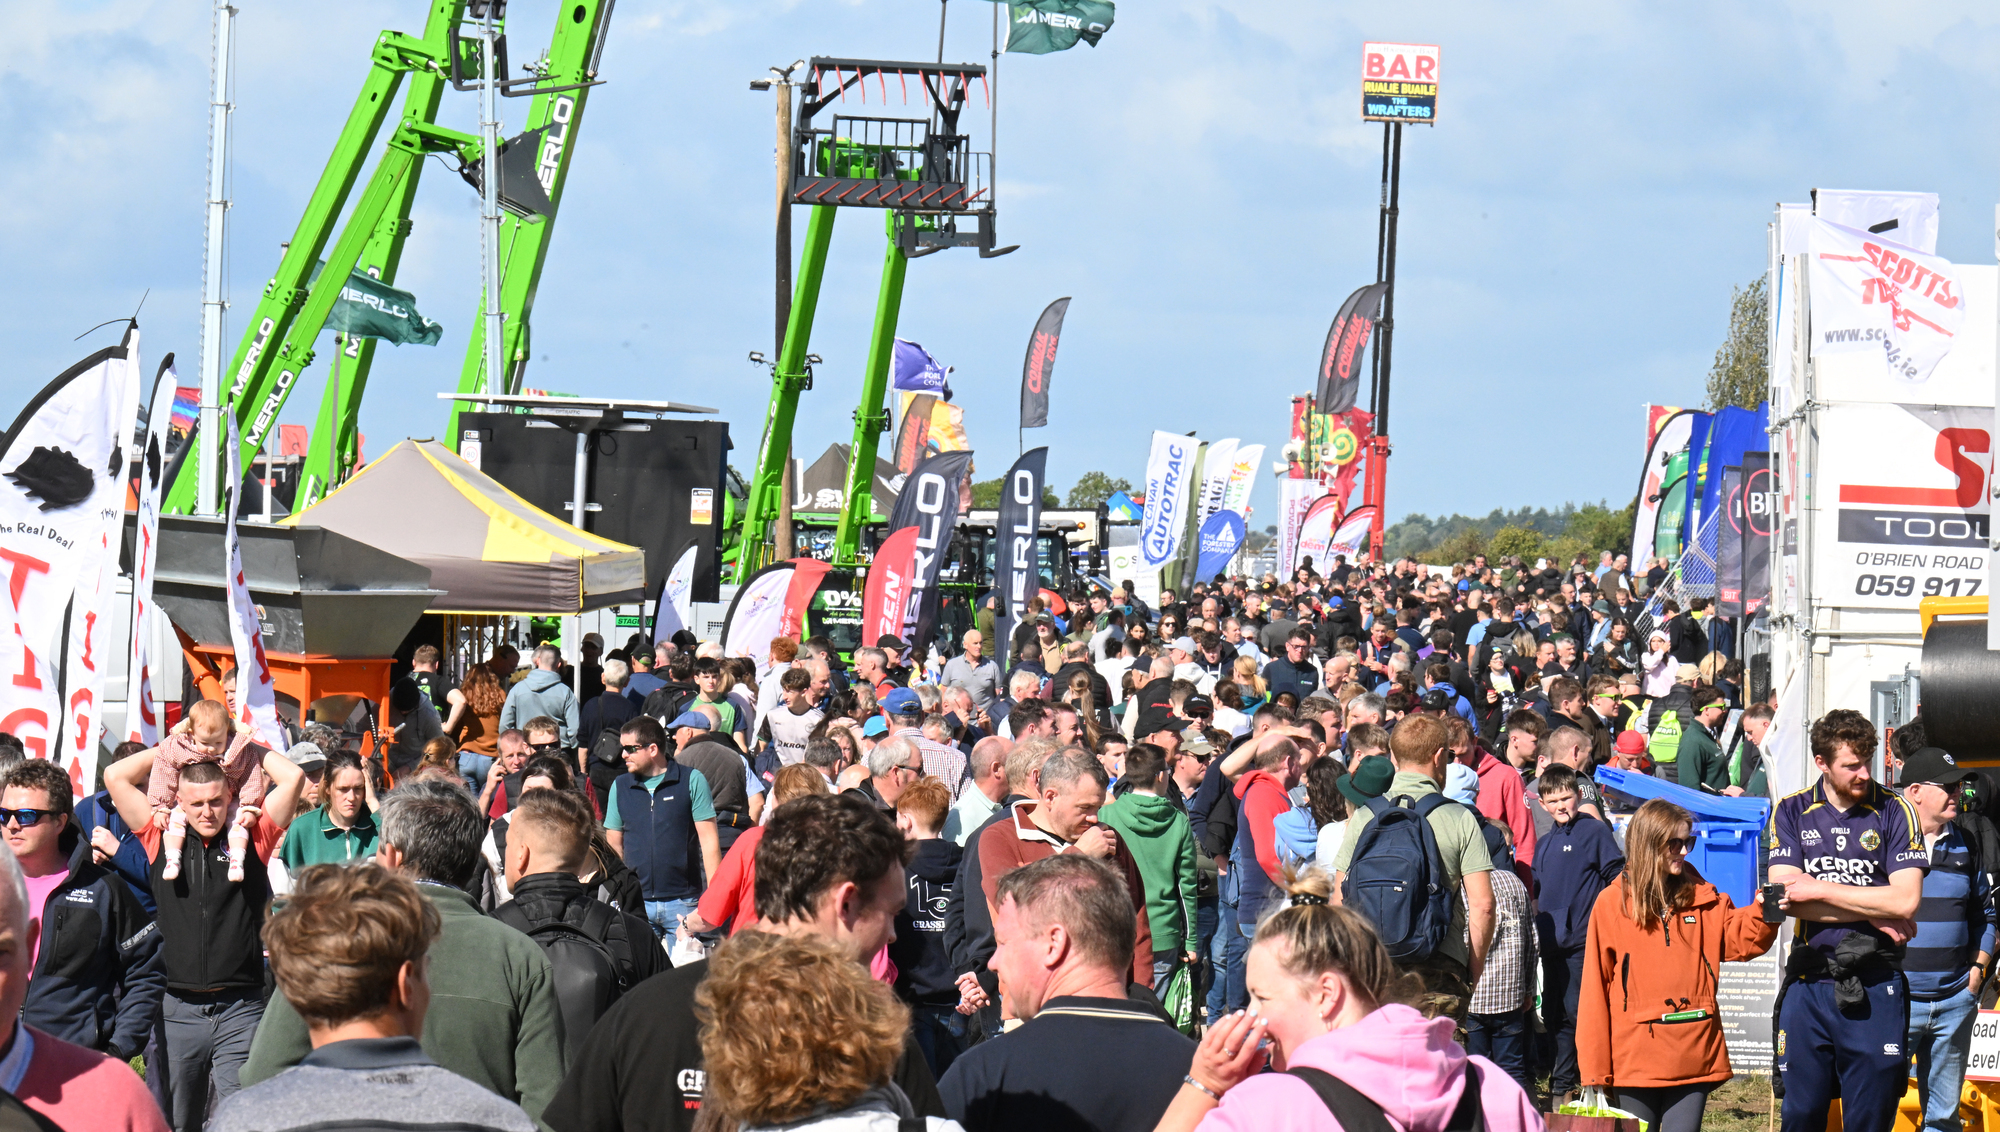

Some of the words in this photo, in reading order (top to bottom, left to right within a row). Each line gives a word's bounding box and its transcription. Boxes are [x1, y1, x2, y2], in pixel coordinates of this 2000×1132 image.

[1366, 52, 1436, 80] BAR
[1364, 81, 1400, 94] RUALIE
[1400, 83, 1436, 96] BUAILE
[1367, 103, 1431, 118] WRAFTERS
[1391, 97, 1408, 105] THE
[537, 97, 574, 197] ERLO
[1862, 241, 1959, 309] SCOTTS
[1338, 312, 1365, 380] CORMAK
[230, 316, 276, 397] MERLO
[1027, 330, 1049, 394] CORMAK
[245, 369, 295, 447] MERLO
[1144, 478, 1159, 521] CAVAN
[1152, 443, 1184, 554] AUTOTRAC
[17, 522, 45, 537] Real
[47, 528, 75, 551] Deal
[1202, 539, 1235, 549] FORESTRY
[1284, 499, 1296, 573] POWERDRIVE
[1300, 539, 1325, 551] dem
[1201, 545, 1235, 554] COMPANY
[1855, 551, 1928, 569] O'BRIEN
[1932, 555, 1984, 570] ROAD
[1723, 590, 1738, 600] BJT
[1855, 573, 1916, 598] 059
[1921, 576, 1983, 598] 917
[824, 589, 863, 607] 0%
[1835, 835, 1847, 851] 9
[1803, 856, 1879, 875] KERRY
[1815, 872, 1873, 886] GROUP
[1972, 1020, 1999, 1039] oad
